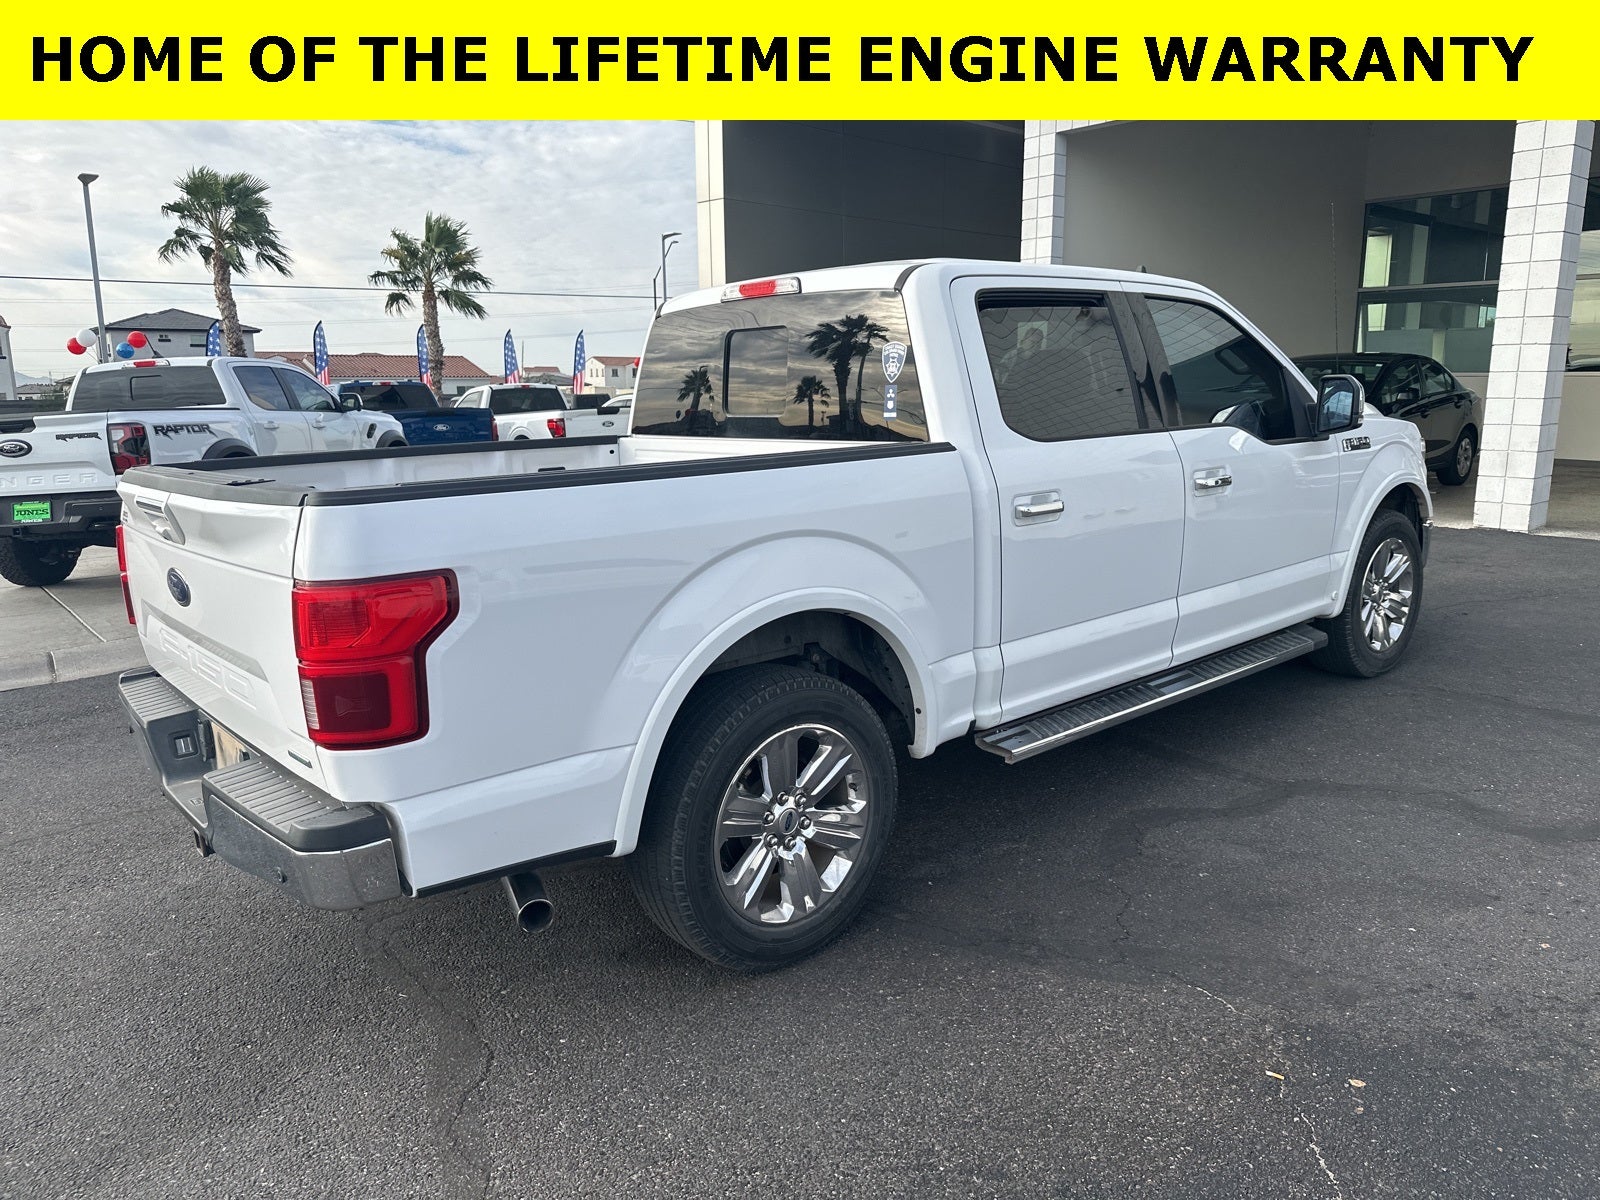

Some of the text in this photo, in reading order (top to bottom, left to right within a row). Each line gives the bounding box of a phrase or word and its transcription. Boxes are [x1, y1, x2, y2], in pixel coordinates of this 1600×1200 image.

[153, 423, 219, 440] RAPTOR
[55, 432, 102, 442] RAPTOR
[15, 508, 49, 516] JONES
